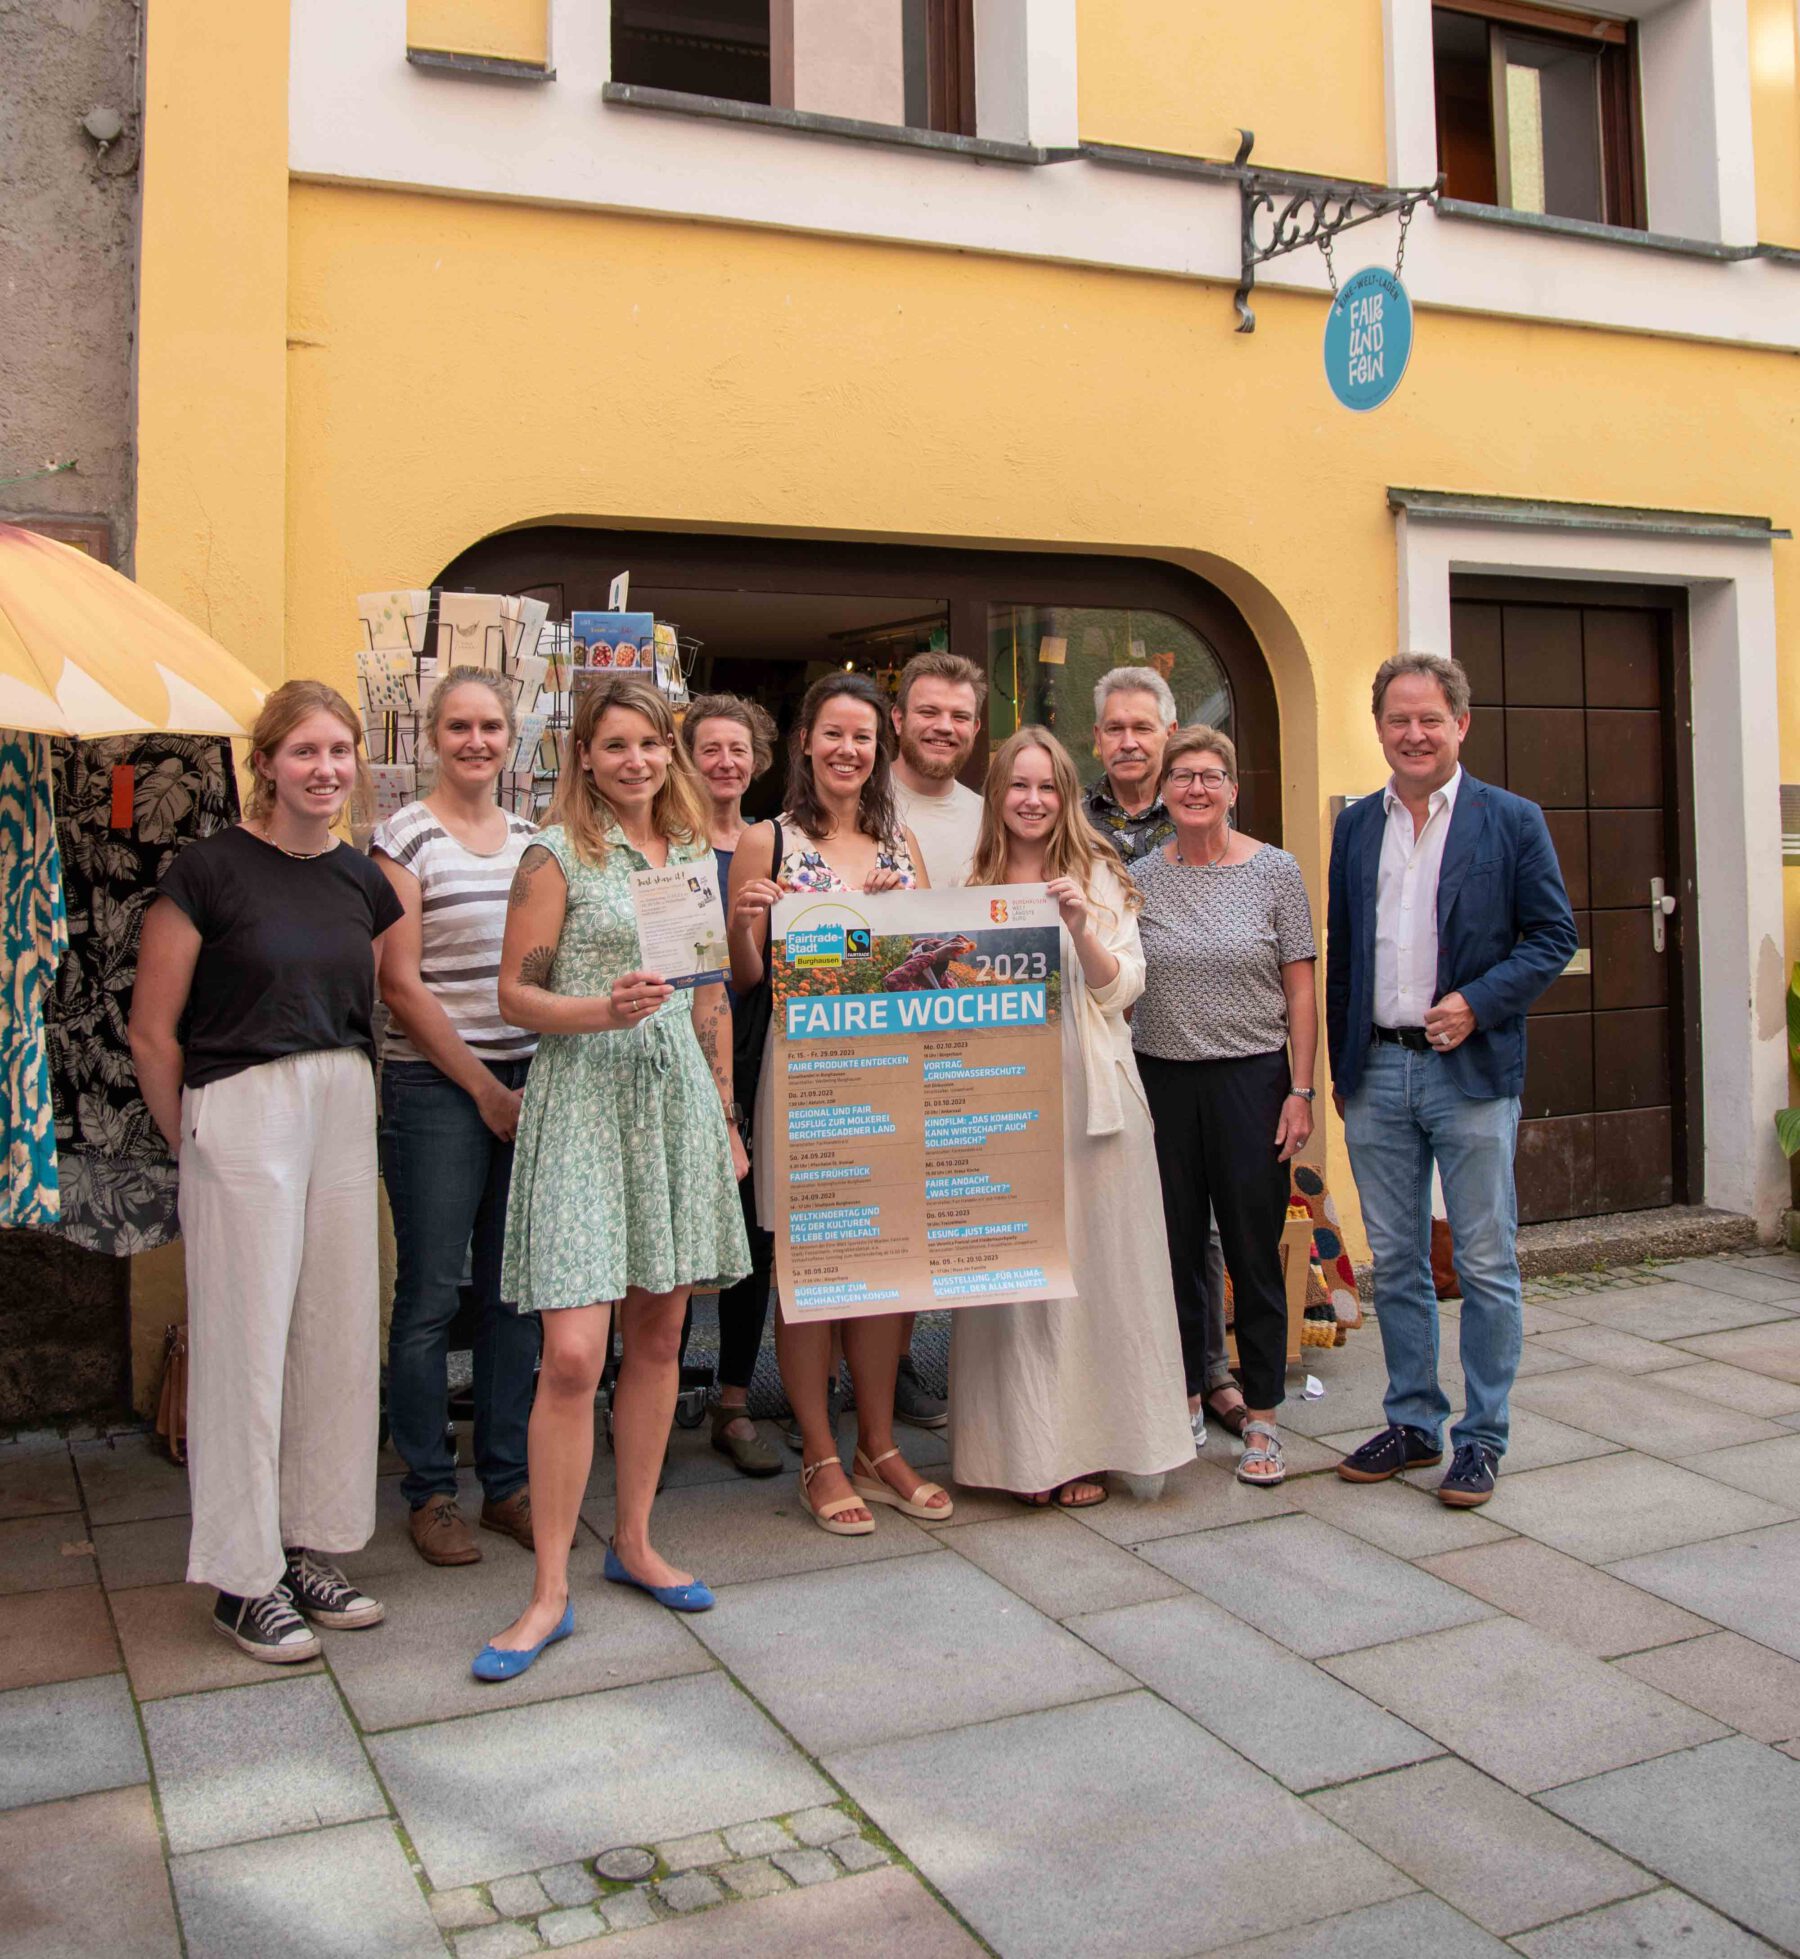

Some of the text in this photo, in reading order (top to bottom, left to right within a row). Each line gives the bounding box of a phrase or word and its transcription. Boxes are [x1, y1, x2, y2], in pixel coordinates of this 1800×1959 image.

[1350, 293, 1384, 328] FAIR
[1350, 324, 1384, 357] UND
[788, 932, 843, 945] Fairtrade-
[788, 943, 818, 954] Stadt
[847, 951, 871, 959] FAIRTRADE
[797, 956, 840, 967] Burghausen
[976, 952, 1047, 982] 2023
[788, 990, 1045, 1034] FAIRE WOCHEN
[936, 1041, 968, 1049] 02.10.2023
[820, 1049, 855, 1057] 29.09.2023
[788, 1056, 910, 1072] FAIRE PRODUKTE ENTDECKEN
[923, 1060, 962, 1070] VORTRAG
[800, 1089, 833, 1098] 21.09.2023
[788, 1105, 872, 1119] REGIONAL UND FAIR
[924, 1117, 967, 1127] KINOFILM:
[990, 1111, 1033, 1122] KOMBINAT
[788, 1114, 890, 1130] AUSFLUG ZUR MOLKEREI
[789, 1124, 896, 1140] BERCHTESGADENER LAND
[925, 1122, 1027, 1137] KANN WIRTSCHAFT AUCH
[789, 1167, 871, 1181] FAIRES FRÜHSTÜCK
[925, 1175, 990, 1188] FAIRE ANDACHT
[950, 1187, 964, 1196] IST
[789, 1207, 880, 1222] WELTKINDERTAG UND
[790, 1218, 871, 1232] TAG DER KULTUREN
[927, 1229, 960, 1239] LESUNG
[984, 1224, 1013, 1234] SHARE
[790, 1234, 801, 1243] ES
[802, 1232, 823, 1241] LEBE
[824, 1231, 838, 1240] DIE
[932, 1273, 990, 1286] AUSSTELLUNG
[794, 1282, 867, 1297] BÜRGERRAT ZUM
[970, 1283, 986, 1293] DER
[988, 1281, 1015, 1291] ALLEN
[796, 1290, 900, 1307] NACHHALTIGEN KONSUM
